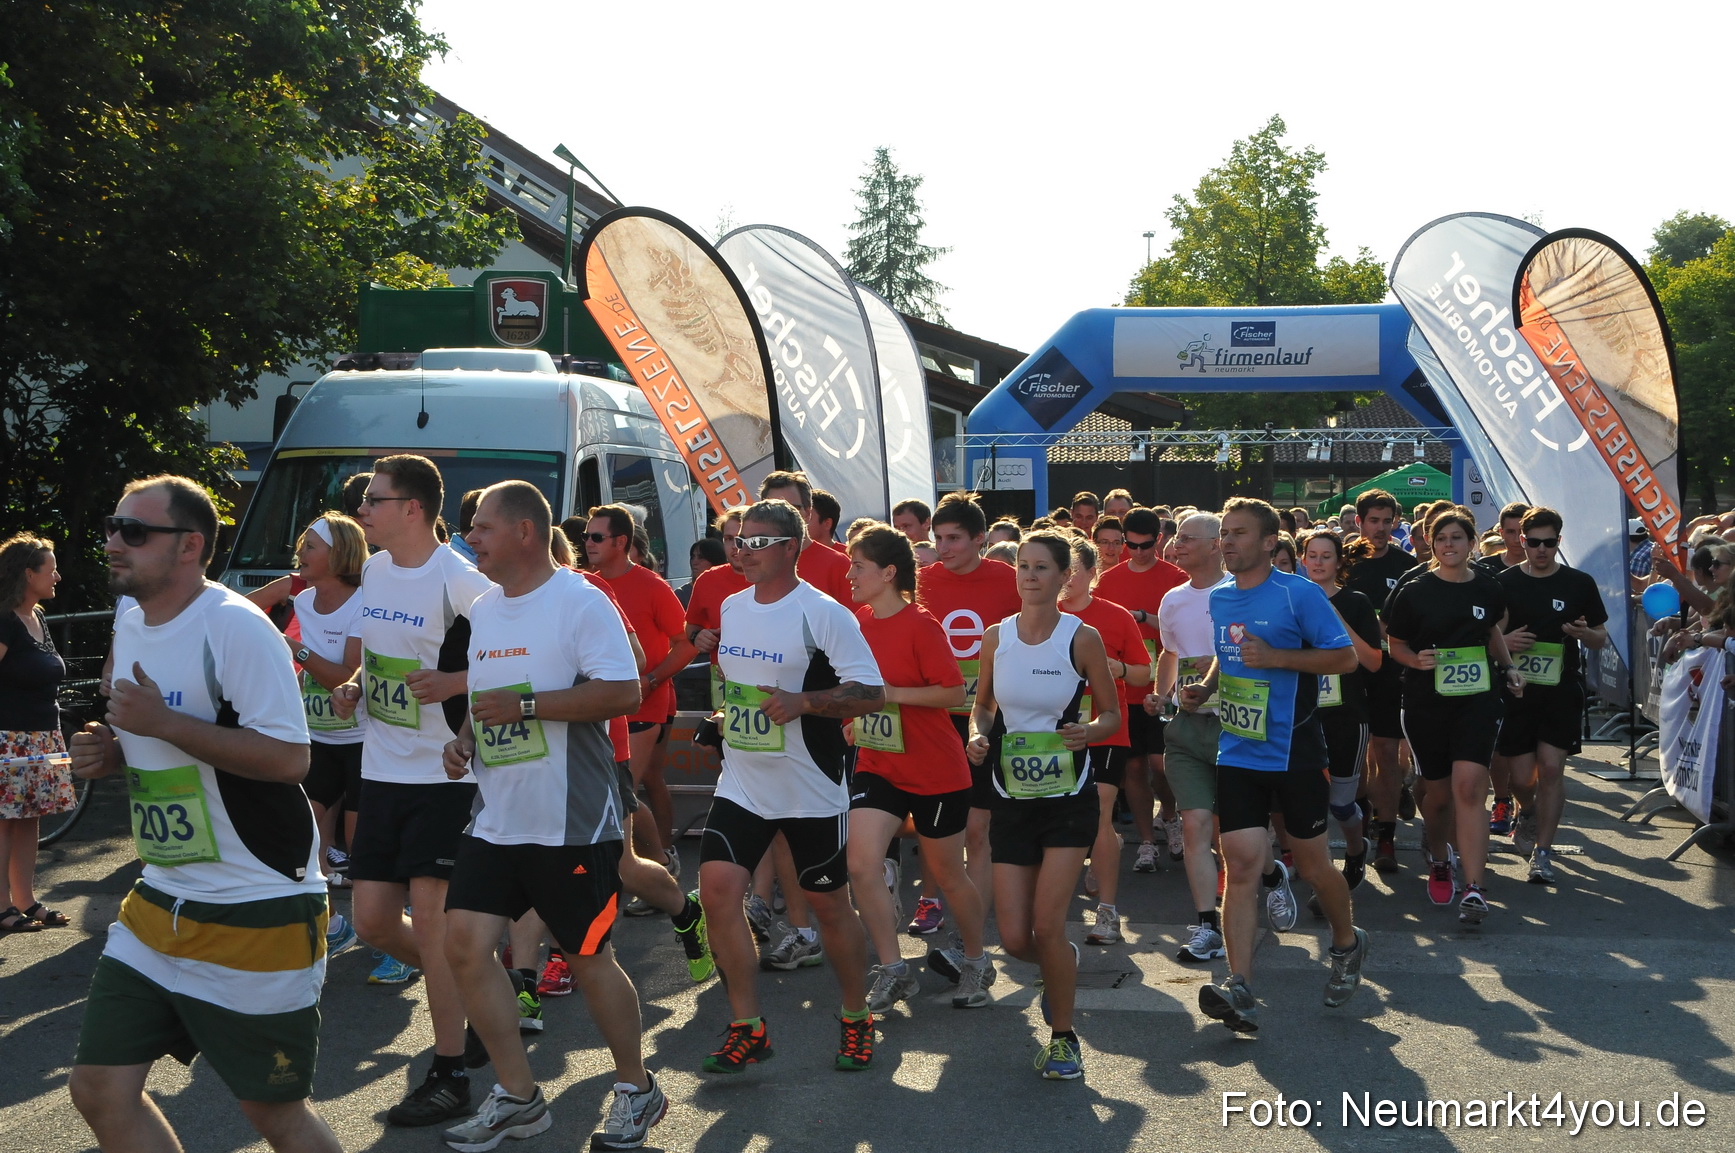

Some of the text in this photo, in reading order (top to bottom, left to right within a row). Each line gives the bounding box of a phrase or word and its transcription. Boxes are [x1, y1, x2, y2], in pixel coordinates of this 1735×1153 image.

[506, 330, 531, 340] 1628
[1240, 330, 1273, 338] Fischer
[1215, 347, 1314, 366] firmenlauf
[1029, 382, 1080, 393] Fischer
[363, 607, 425, 628] DELPHI
[488, 647, 531, 659] KLEBL
[719, 645, 783, 663] DELPHI
[1032, 668, 1062, 676] Elisabeth
[1443, 663, 1482, 684] 259
[1518, 655, 1554, 674] 267
[369, 675, 409, 710] 214
[729, 705, 771, 735] 210
[860, 713, 893, 738] 170
[1220, 699, 1263, 731] 5037
[482, 718, 531, 748] 524
[1010, 755, 1063, 782] 884
[133, 802, 195, 843] 203
